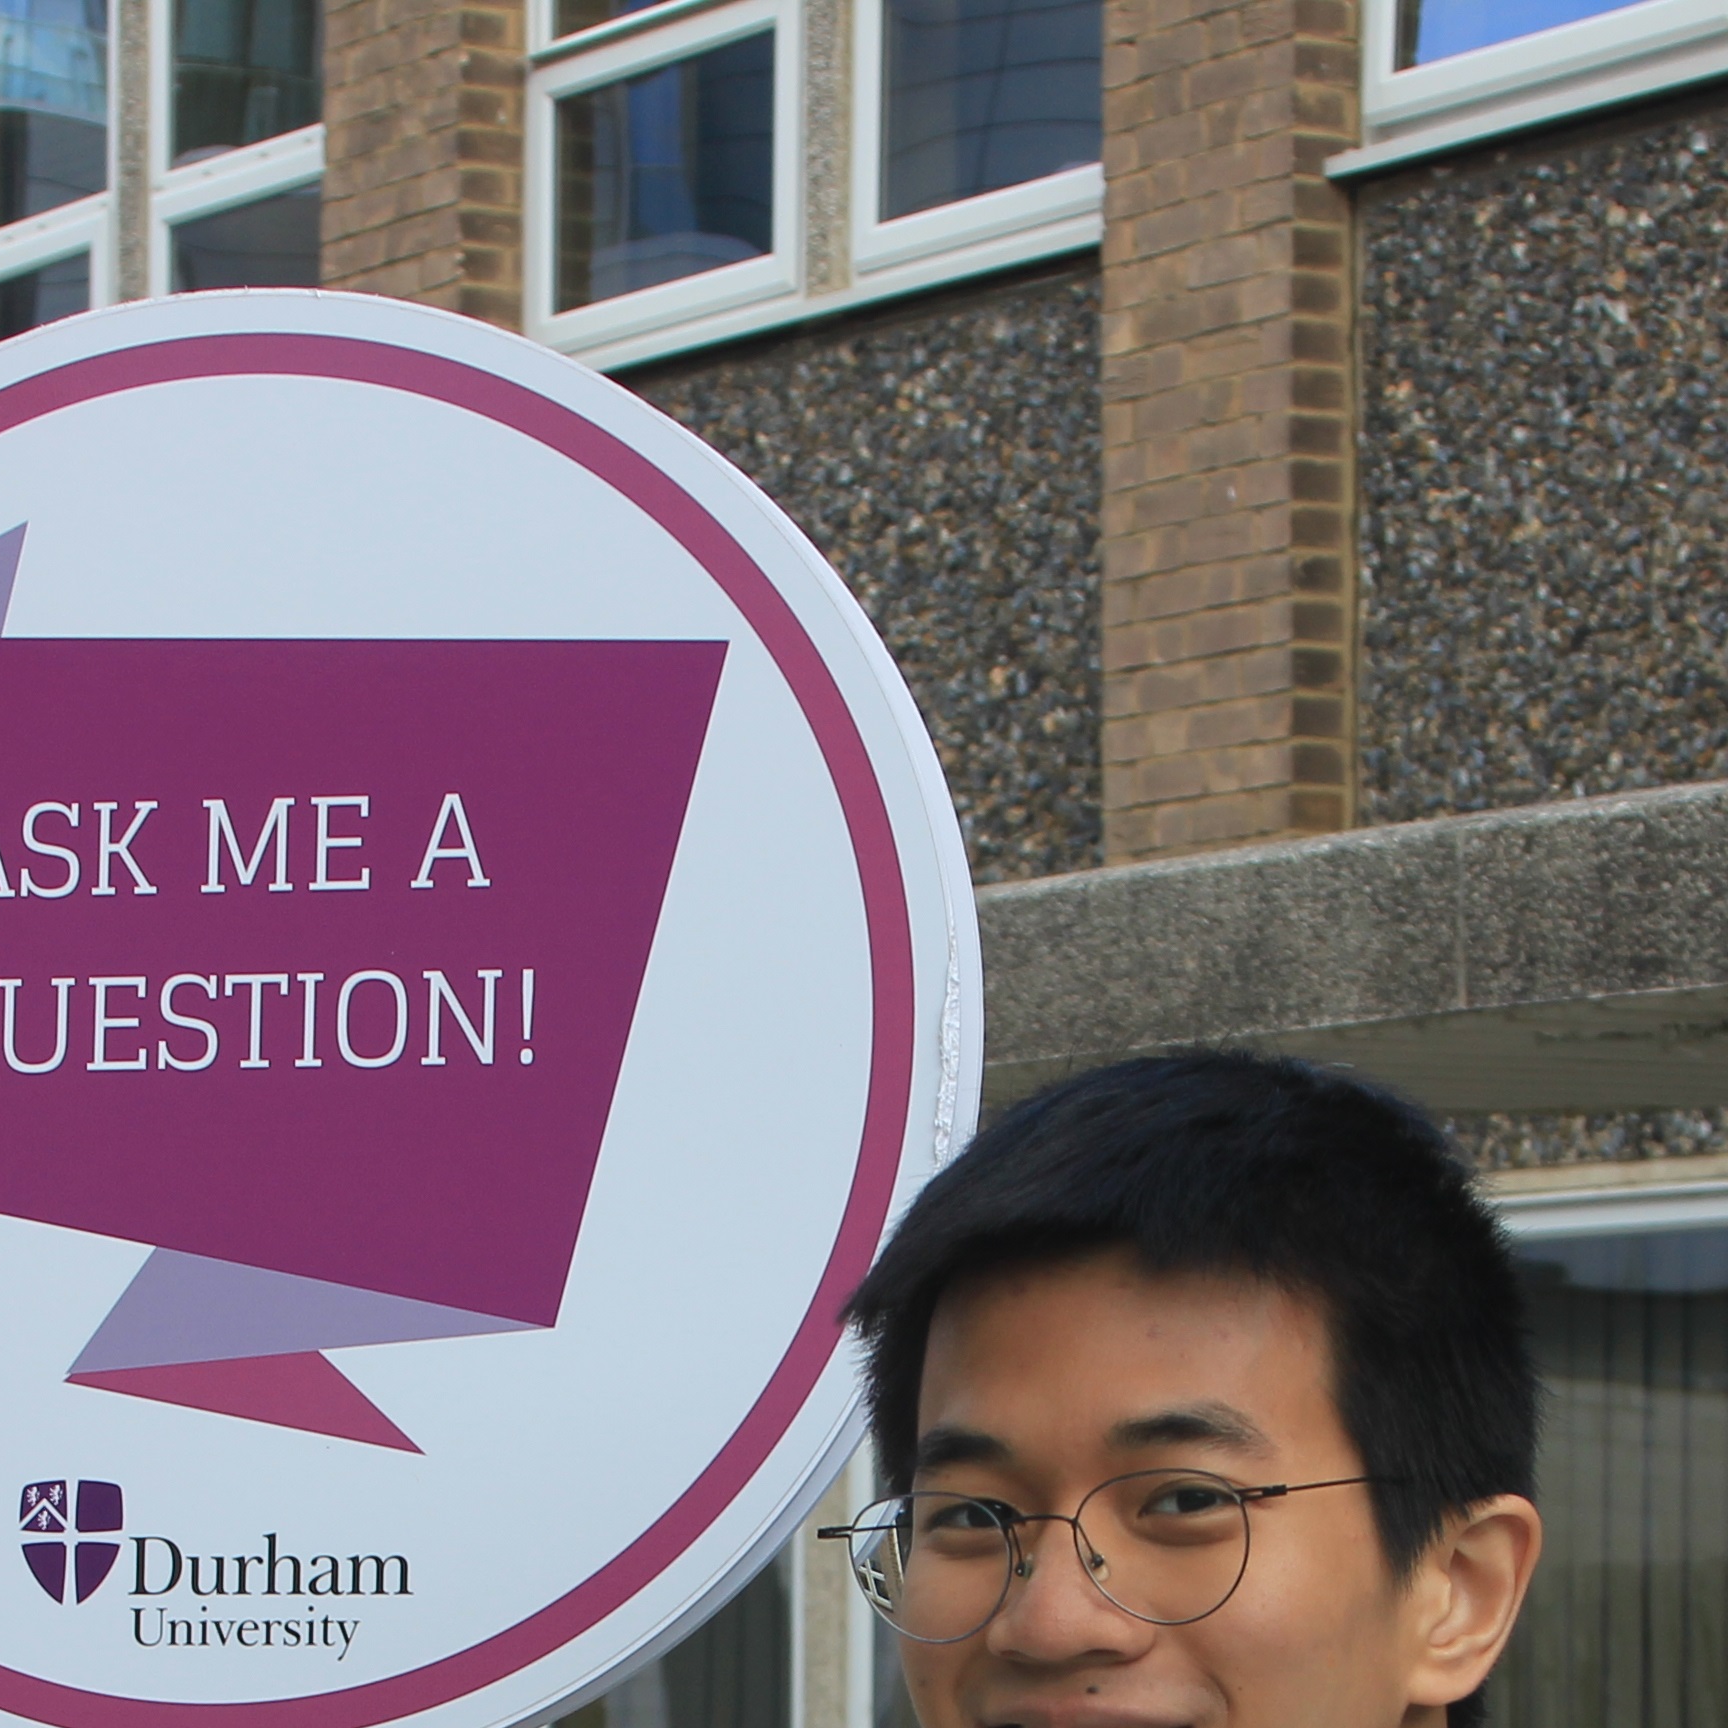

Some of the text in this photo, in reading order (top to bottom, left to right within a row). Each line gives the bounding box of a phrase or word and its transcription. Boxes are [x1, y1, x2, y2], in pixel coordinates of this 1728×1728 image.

[200, 795, 371, 893] ME
[410, 793, 491, 889] A
[128, 1532, 413, 1597] Durham
[130, 1605, 360, 1661] University
